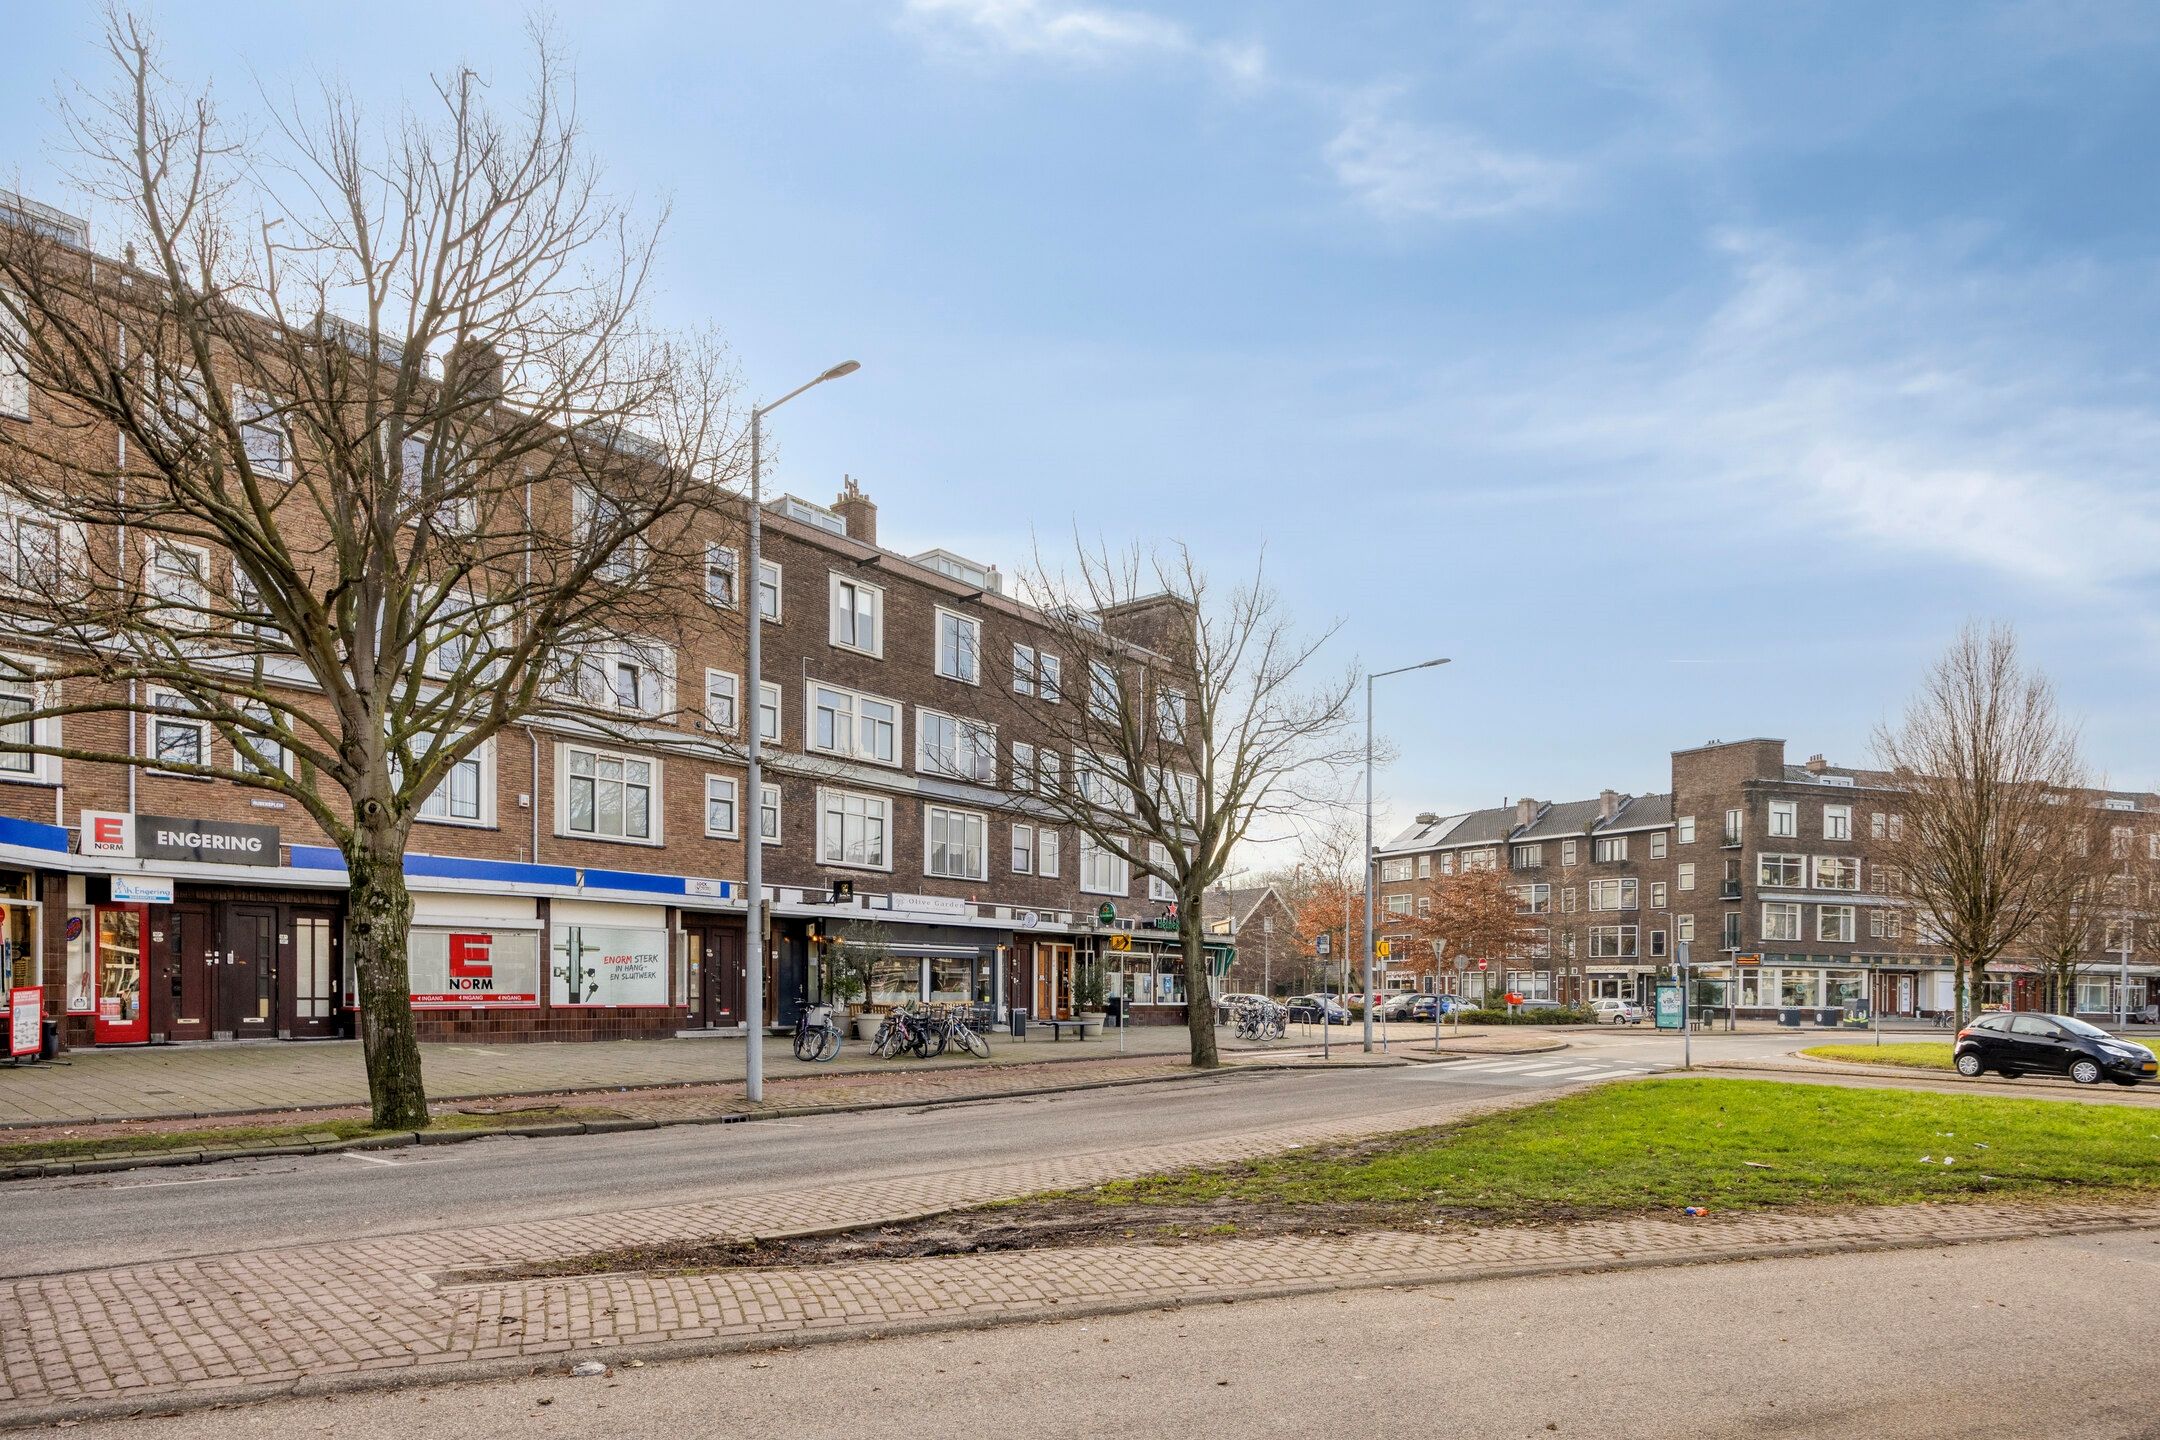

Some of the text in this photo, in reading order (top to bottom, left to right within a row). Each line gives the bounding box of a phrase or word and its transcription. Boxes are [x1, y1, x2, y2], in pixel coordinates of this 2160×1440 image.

[95, 817, 123, 844] E
[157, 830, 262, 852] ENGERING
[95, 843, 124, 851] NORM
[908, 898, 931, 906] Olive
[934, 900, 964, 909] Garden
[449, 933, 493, 978] E
[603, 954, 659, 965] ENORM STERK
[610, 971, 657, 981] EN SLUITWERK
[449, 978, 494, 990] NORM
